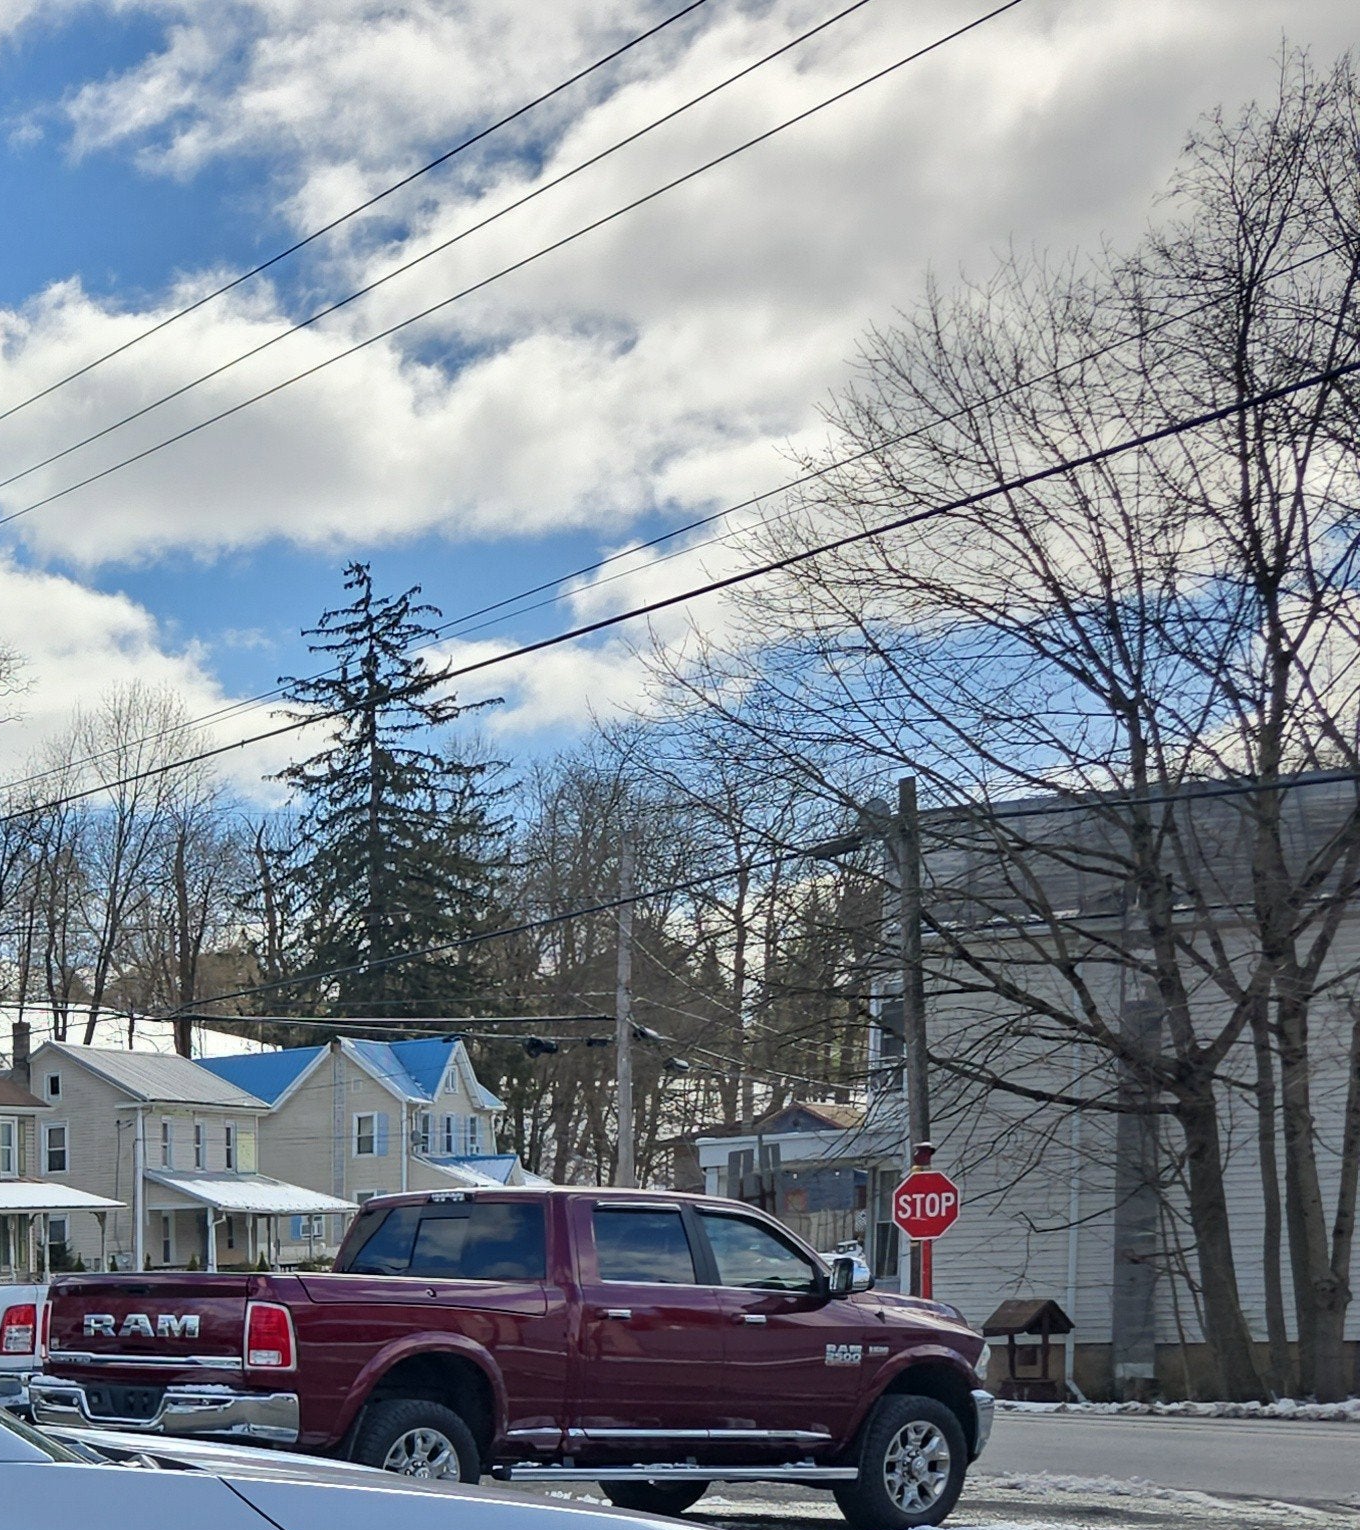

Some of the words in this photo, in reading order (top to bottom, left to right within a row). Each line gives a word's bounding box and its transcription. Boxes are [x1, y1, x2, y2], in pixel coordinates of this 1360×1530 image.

[898, 1192, 955, 1219] STOP
[83, 1313, 200, 1338] RAM
[825, 1344, 863, 1353] RAM
